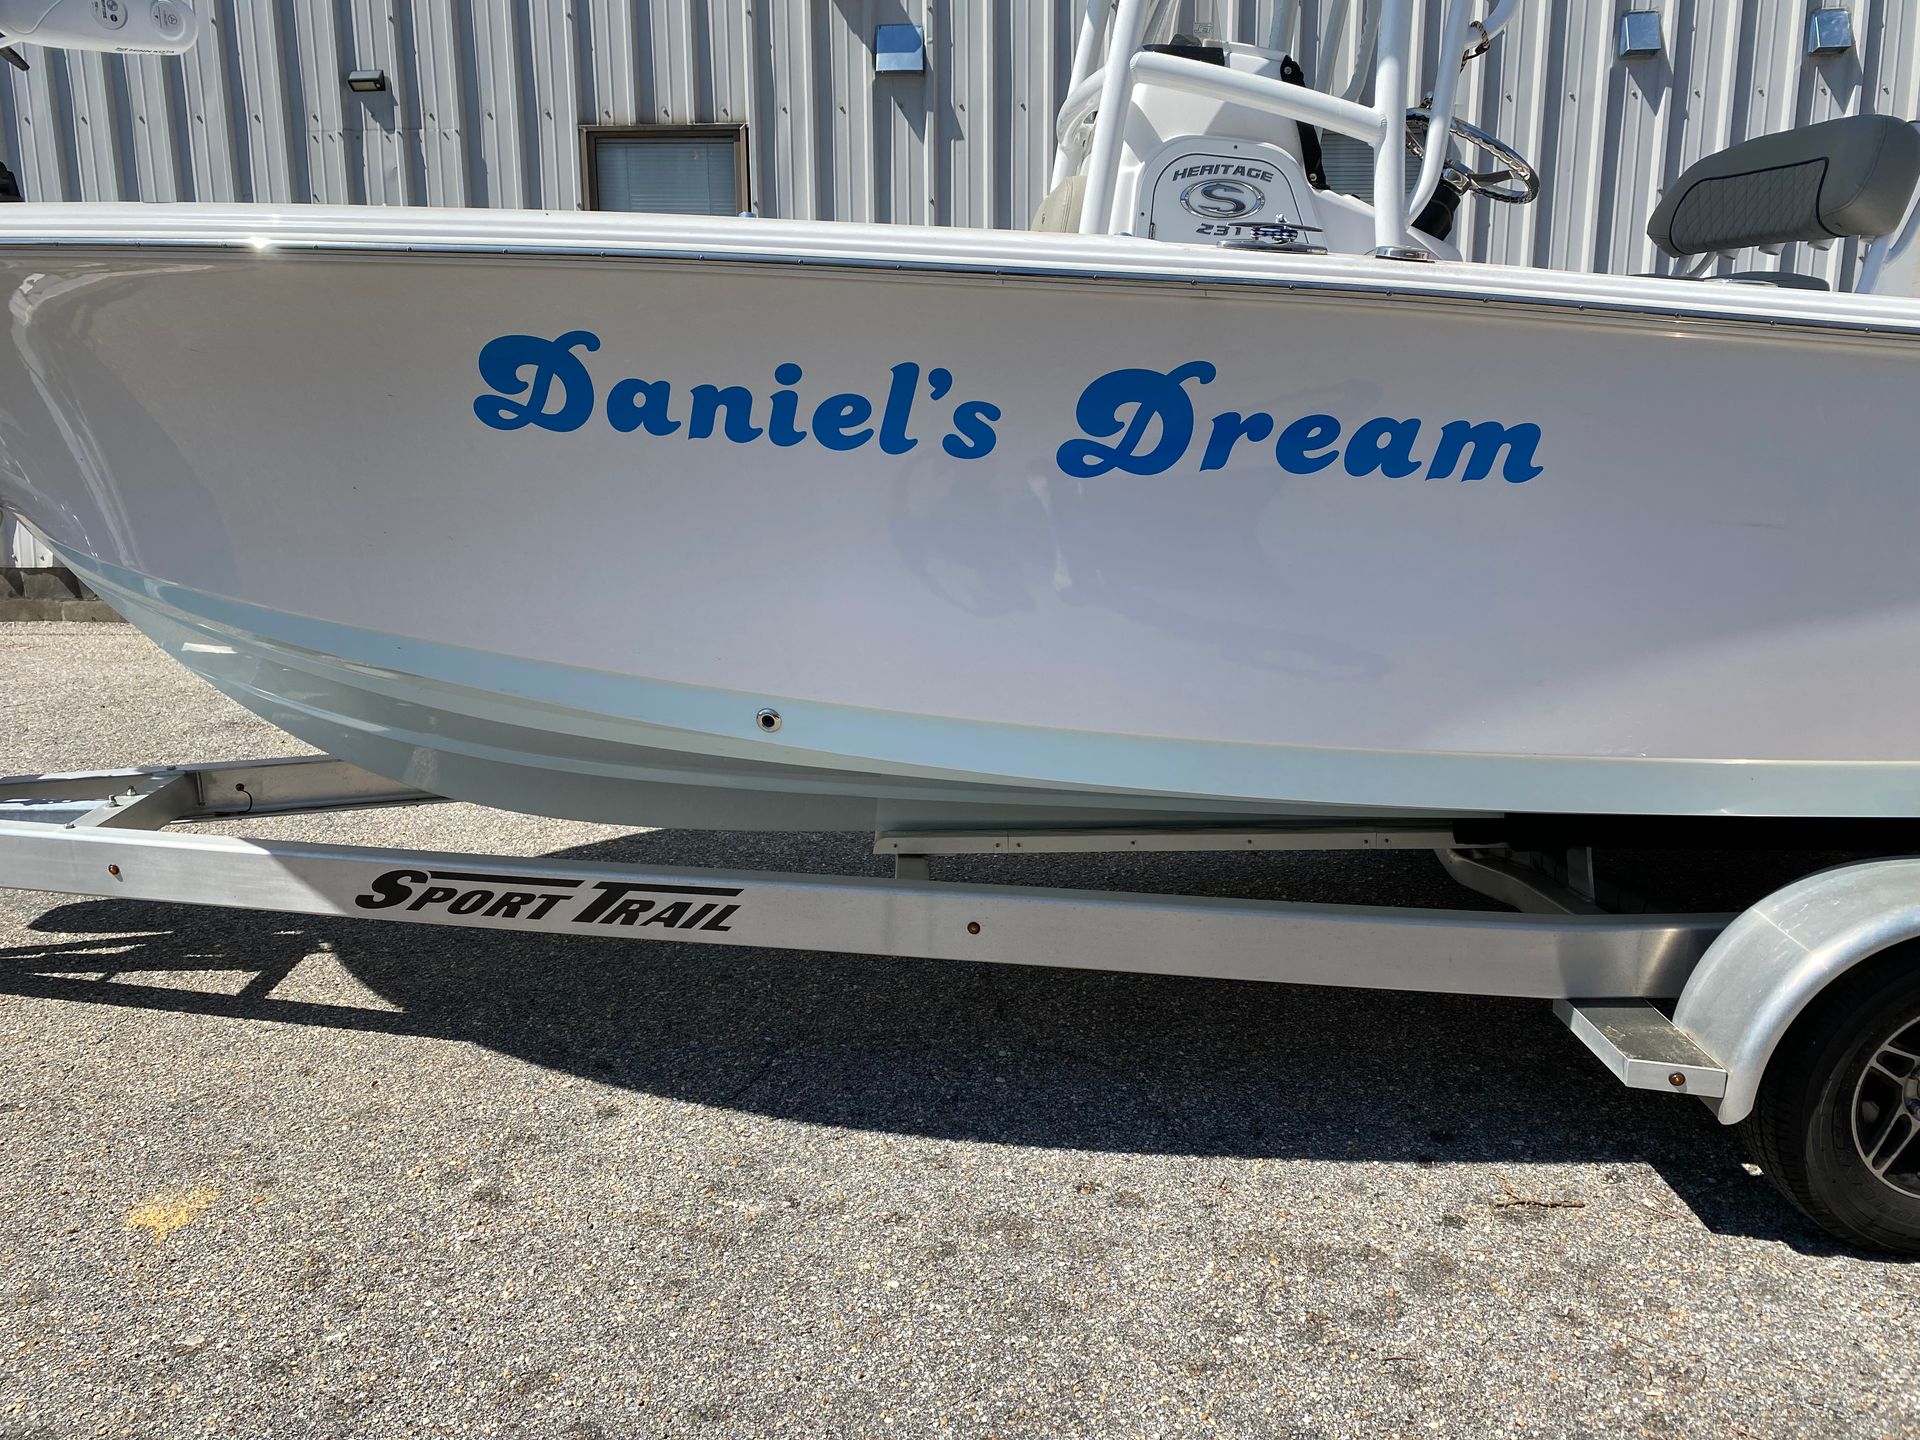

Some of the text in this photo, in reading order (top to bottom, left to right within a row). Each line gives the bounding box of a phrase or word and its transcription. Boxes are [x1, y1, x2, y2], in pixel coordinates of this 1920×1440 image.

[1173, 164, 1274, 182] HERITAGE
[474, 330, 1544, 484] Daniel's Dream
[355, 870, 745, 932] SPORT TRAIL
